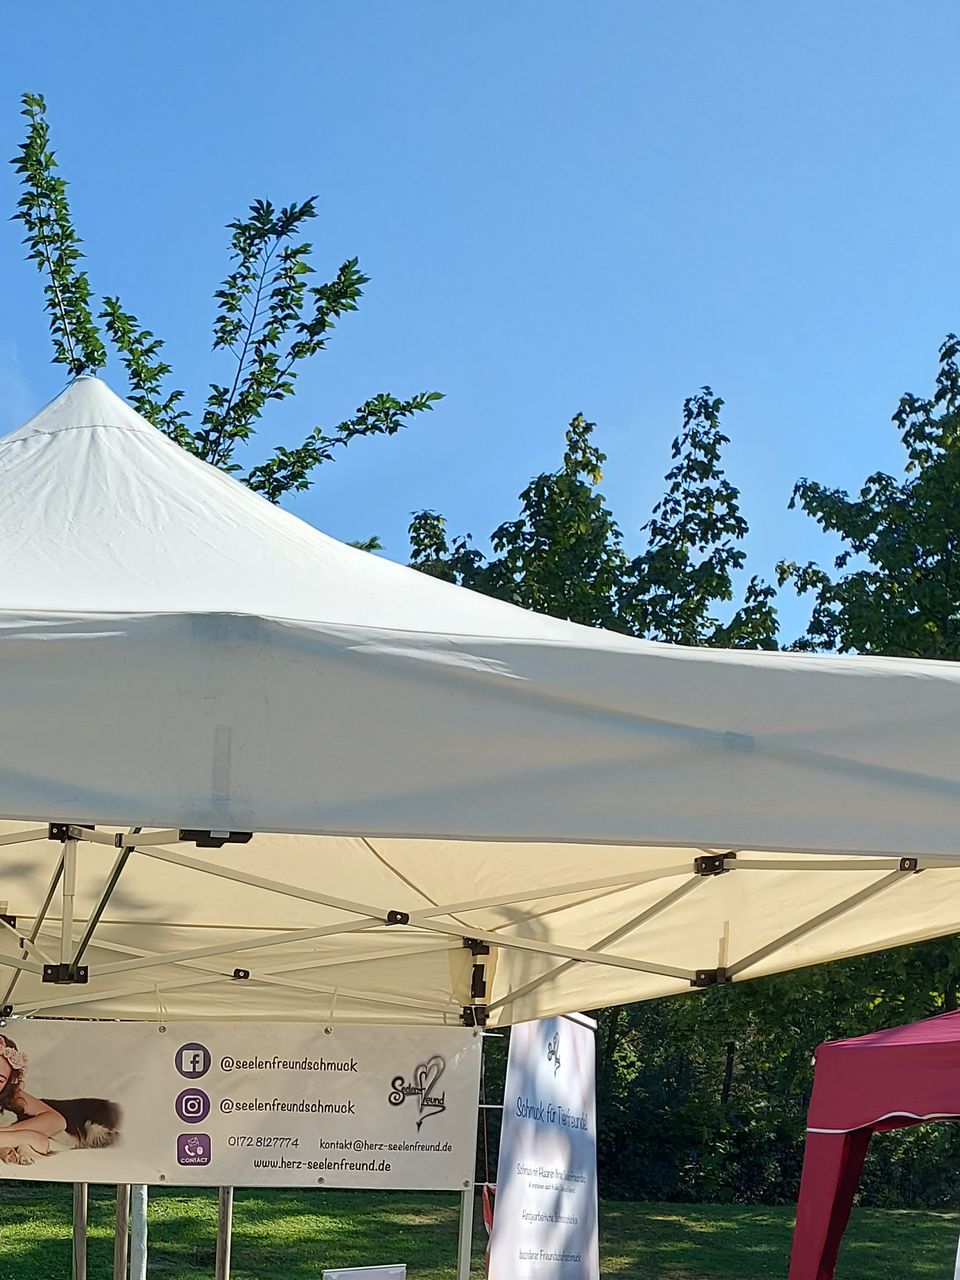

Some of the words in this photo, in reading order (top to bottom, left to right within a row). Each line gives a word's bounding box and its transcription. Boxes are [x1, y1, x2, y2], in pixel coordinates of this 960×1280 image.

[220, 1056, 358, 1072] @seelenfreundschmuck
[220, 1098, 355, 1114] @seelenfreundschmuck
[515, 1096, 544, 1123] Schmuck
[547, 1103, 557, 1123] für
[228, 1136, 254, 1147] 0172
[255, 1136, 300, 1148] 8127774
[319, 1138, 453, 1152] kontakt@herz-seelenfreund.de
[253, 1156, 391, 1172] www.herz-seelenfreund.de
